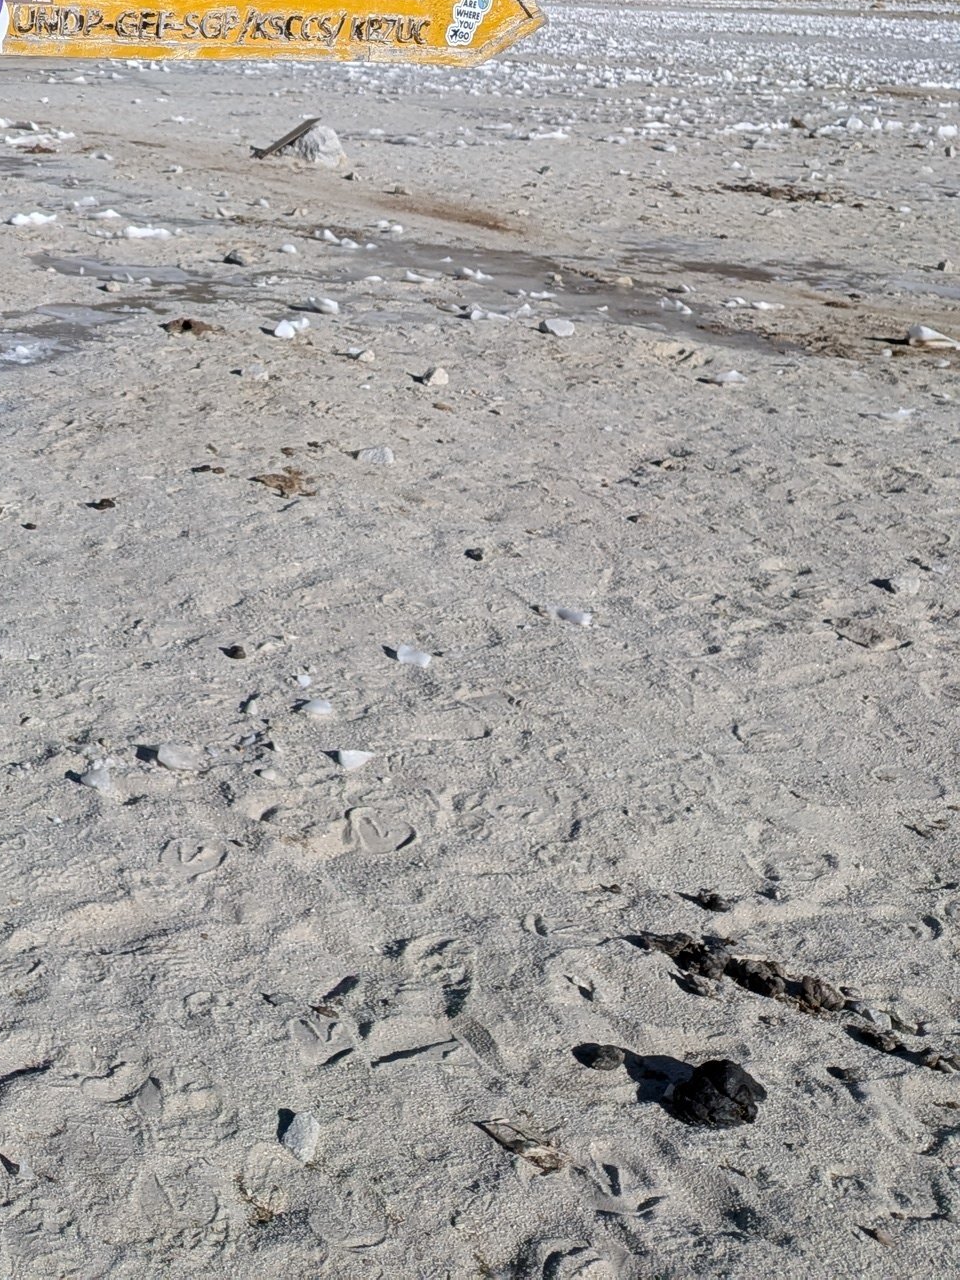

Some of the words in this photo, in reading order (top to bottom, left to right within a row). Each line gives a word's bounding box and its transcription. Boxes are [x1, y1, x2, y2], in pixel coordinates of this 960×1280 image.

[462, 0, 478, 9] ARE
[456, 8, 481, 21] WHERE
[459, 20, 474, 30] YOU
[458, 30, 470, 40] GO
